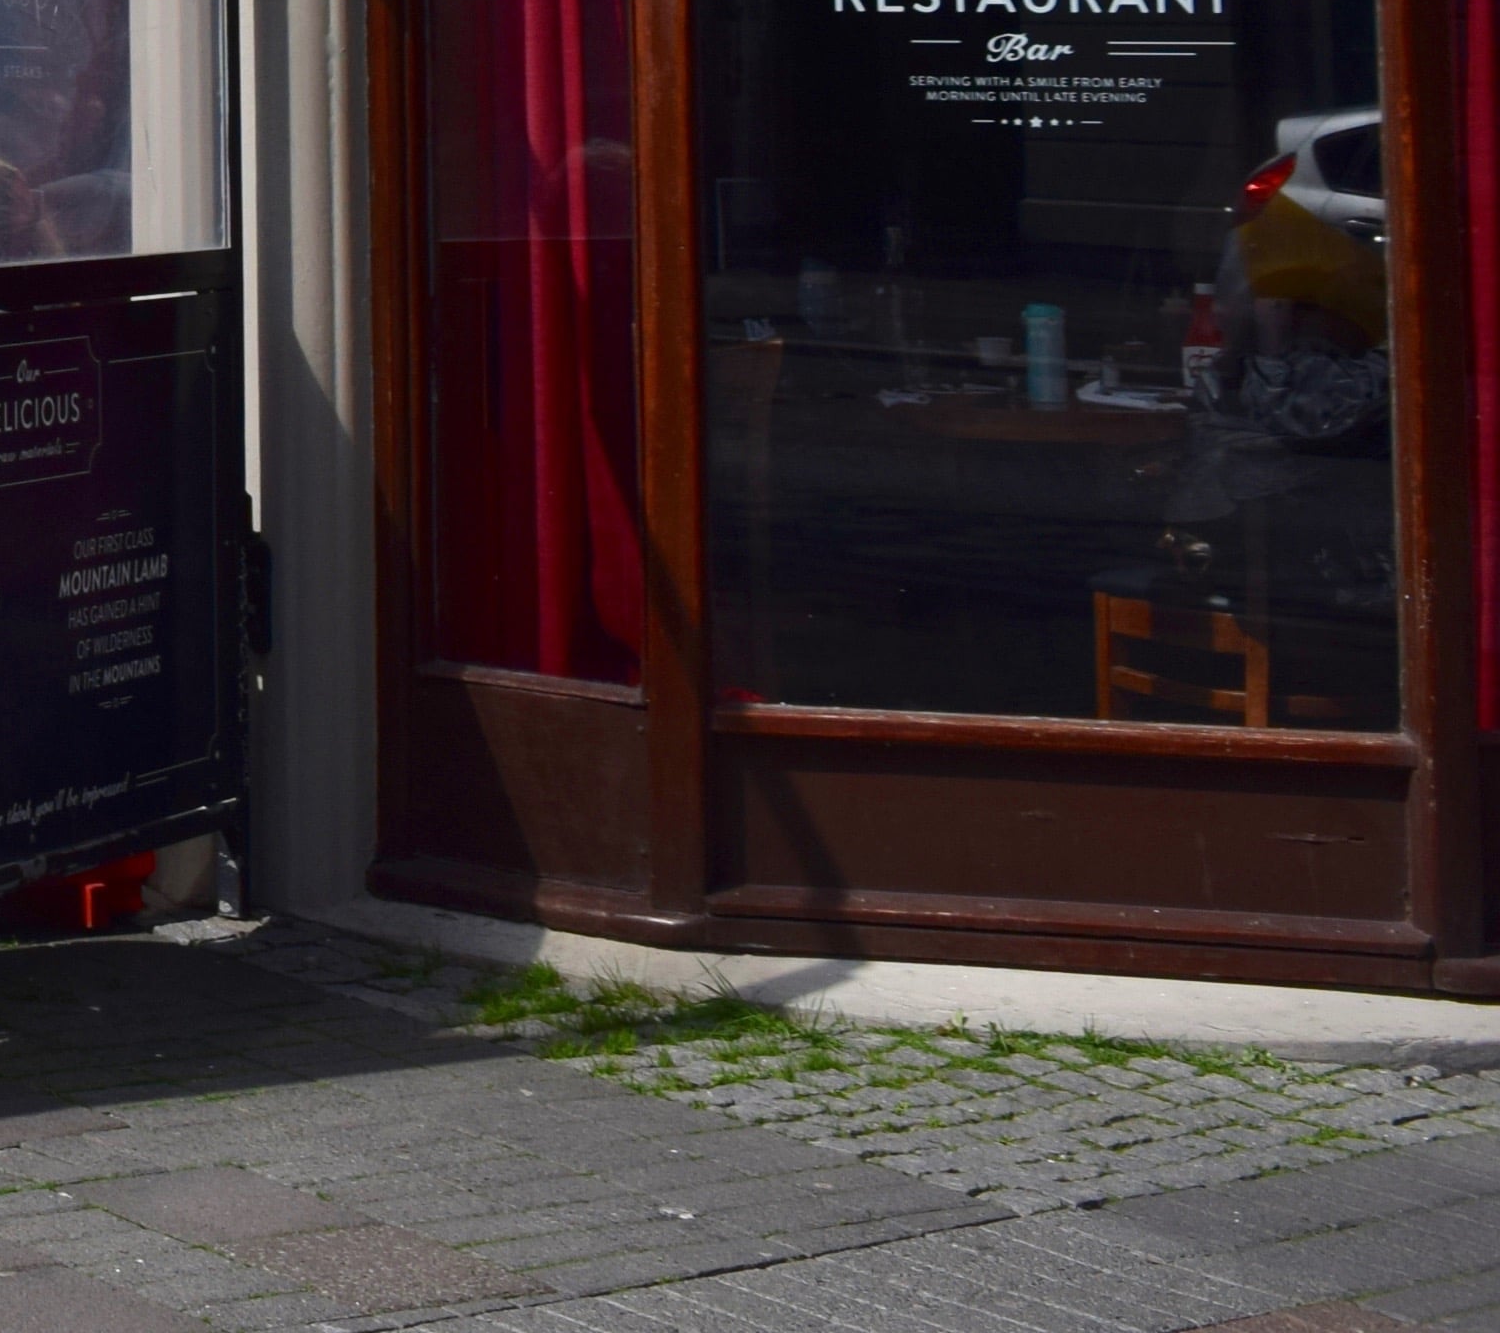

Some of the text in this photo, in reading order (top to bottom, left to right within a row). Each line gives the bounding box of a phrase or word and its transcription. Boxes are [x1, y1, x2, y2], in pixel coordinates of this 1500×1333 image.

[986, 32, 1075, 63] Bar
[908, 75, 1163, 89] SERVING WITH A SMILE FROM EARLY
[925, 90, 1148, 104] MORNING UNTIL LATE EVENING
[16, 358, 41, 383] Our
[58, 552, 169, 599] MOUNTAIN LAMB
